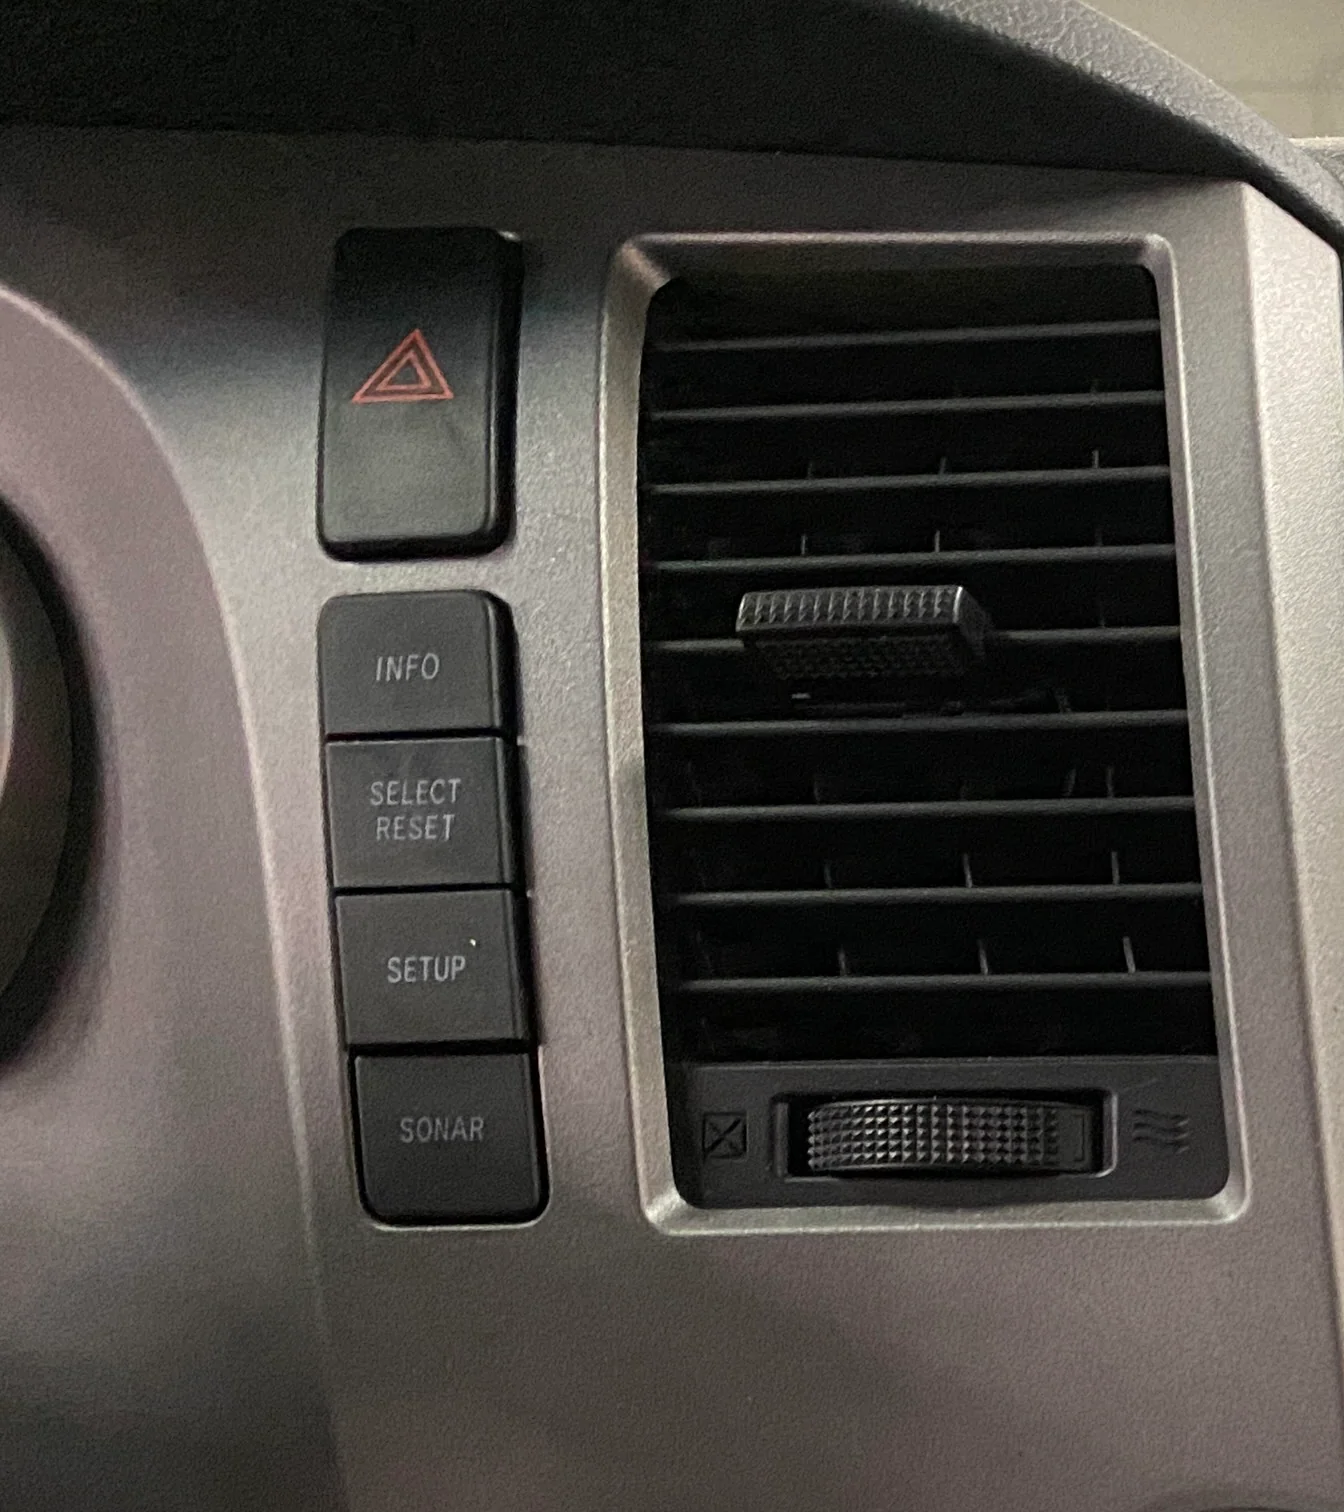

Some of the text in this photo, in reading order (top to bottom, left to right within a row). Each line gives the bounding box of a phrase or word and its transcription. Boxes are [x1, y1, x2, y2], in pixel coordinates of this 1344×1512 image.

[375, 652, 440, 682] INFO
[369, 777, 462, 807] SELECT
[376, 813, 455, 841] RESET
[387, 955, 466, 984] SETUP
[400, 1115, 484, 1143] SONAR
